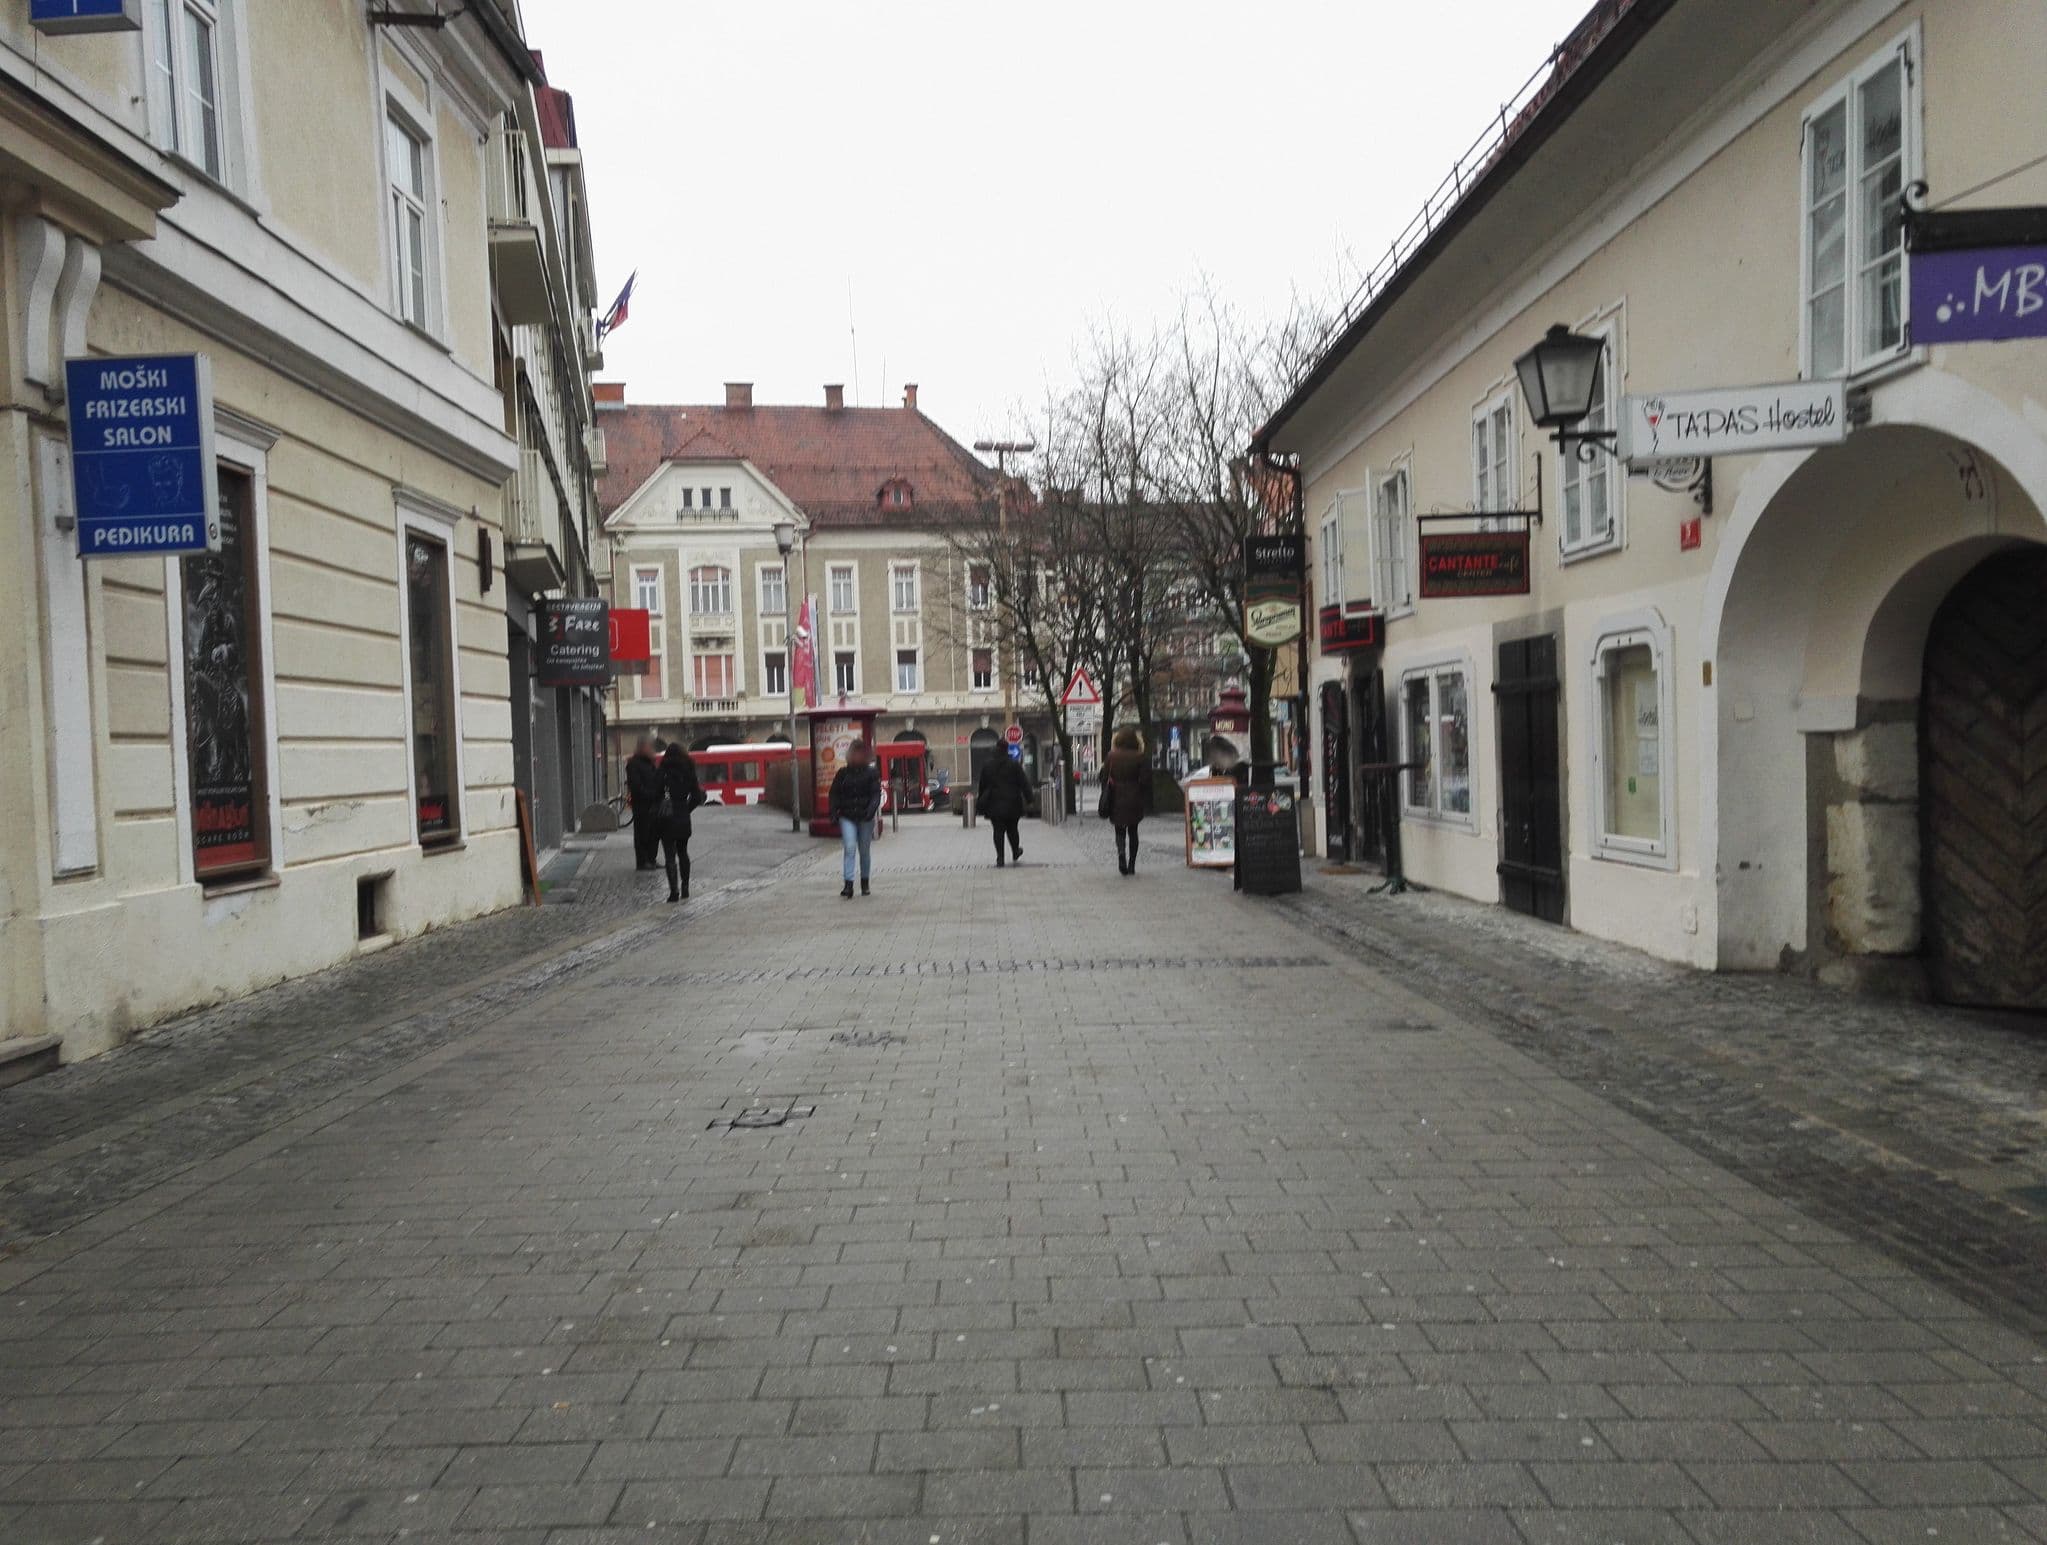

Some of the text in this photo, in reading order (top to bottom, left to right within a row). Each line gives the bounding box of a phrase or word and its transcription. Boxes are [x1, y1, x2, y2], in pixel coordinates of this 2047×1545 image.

[100, 365, 167, 390] MOŠKI
[85, 396, 186, 419] FRIZERSKI
[1763, 395, 1835, 433] Hostel
[103, 425, 172, 446] SALON
[94, 523, 194, 547] PEDIKURA
[550, 644, 600, 657] Catering
